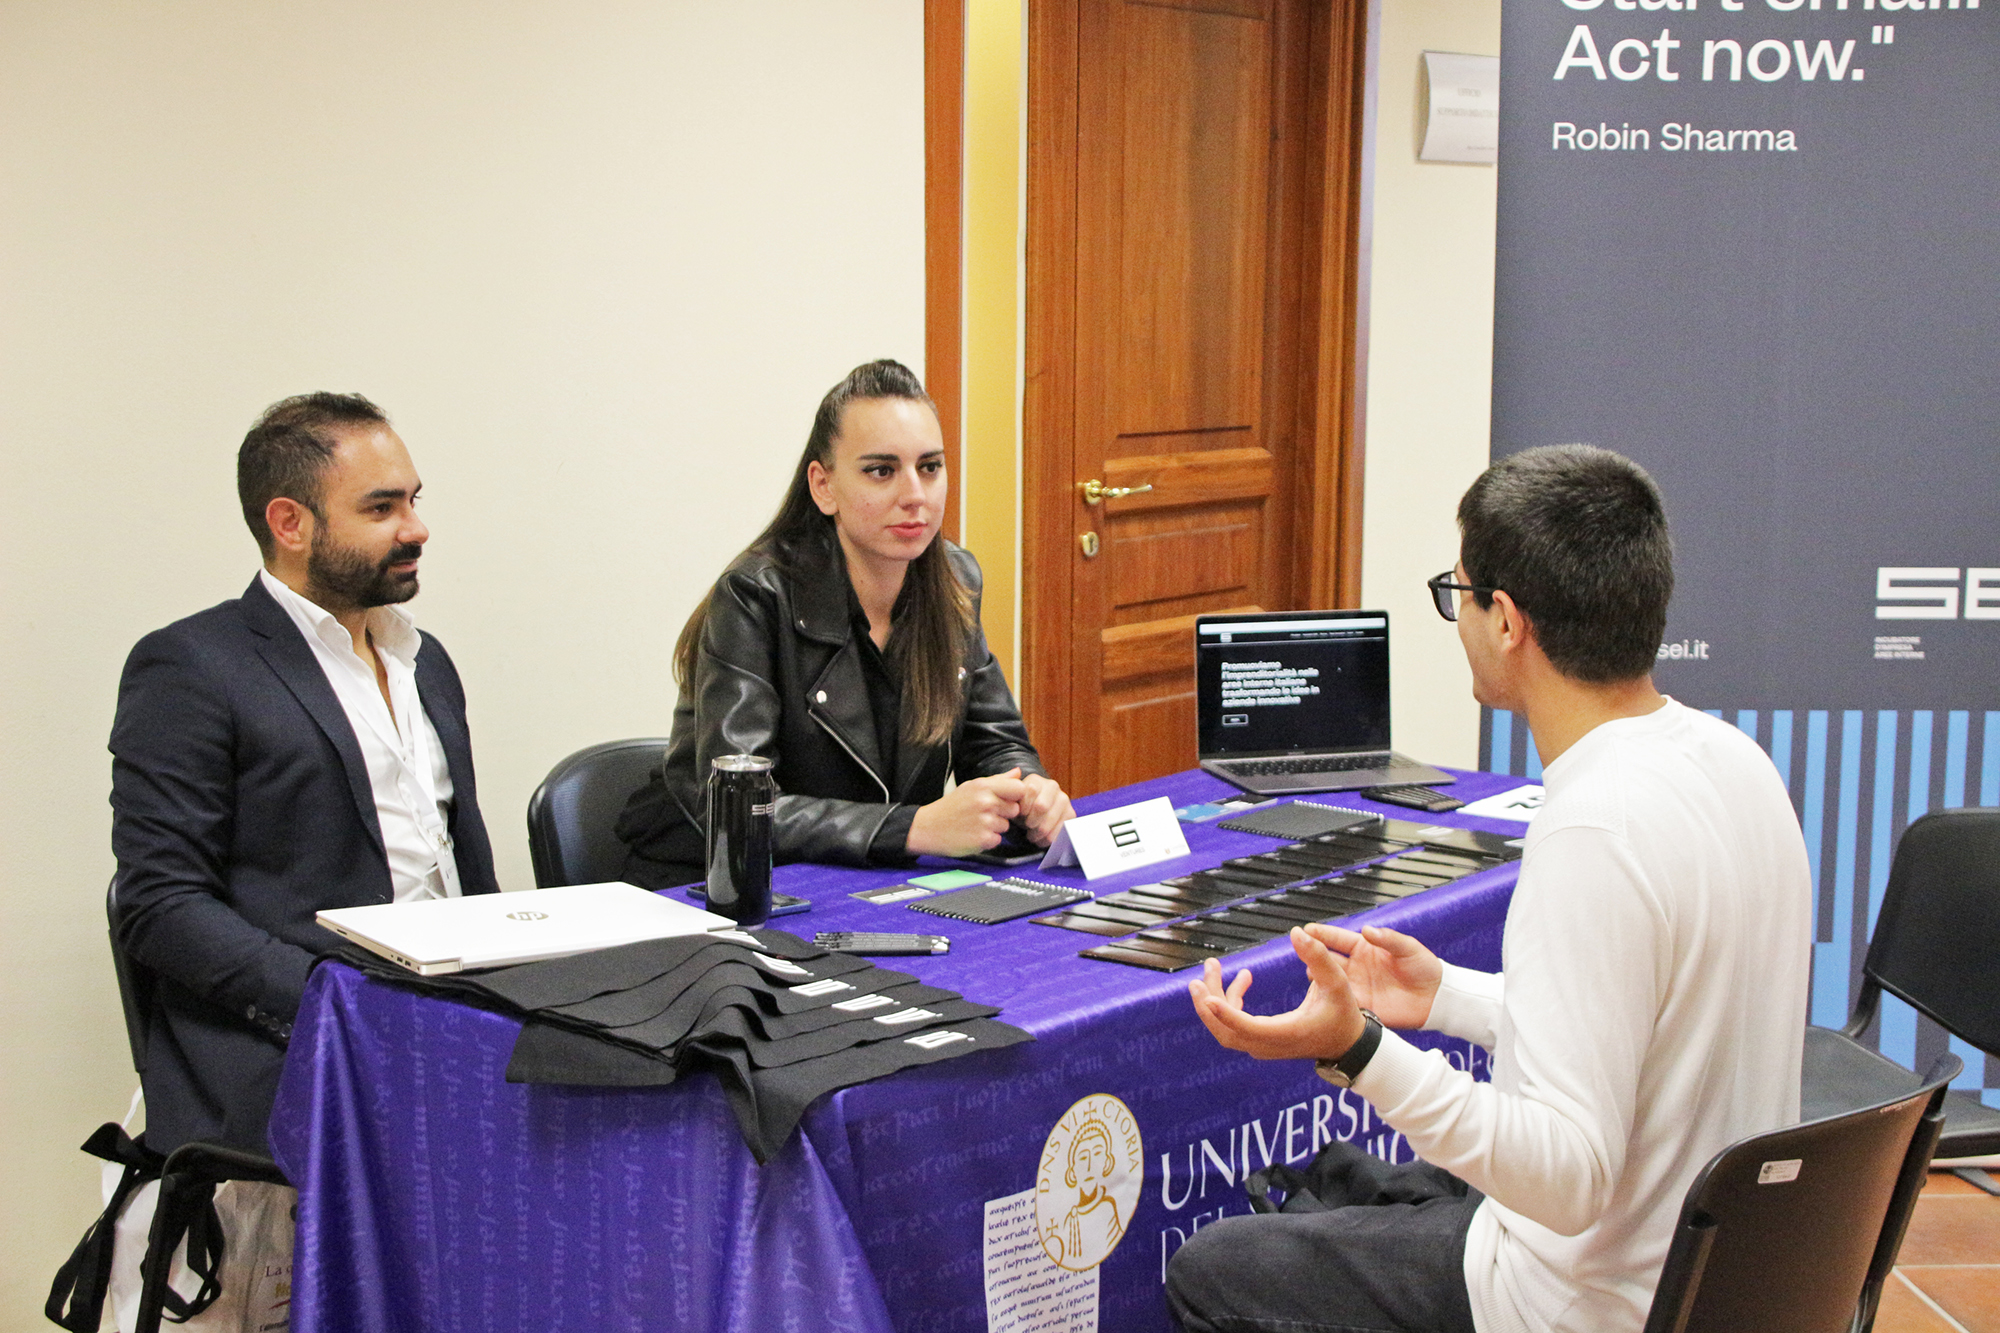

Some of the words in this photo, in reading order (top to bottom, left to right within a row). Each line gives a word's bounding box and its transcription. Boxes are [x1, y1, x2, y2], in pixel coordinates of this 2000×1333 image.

[1553, 24, 1680, 81] Act
[1702, 25, 1895, 81] now."
[1552, 122, 1650, 151] Robin
[1660, 122, 1798, 151] Sharma
[1161, 1087, 1387, 1211] UNIVERSI
